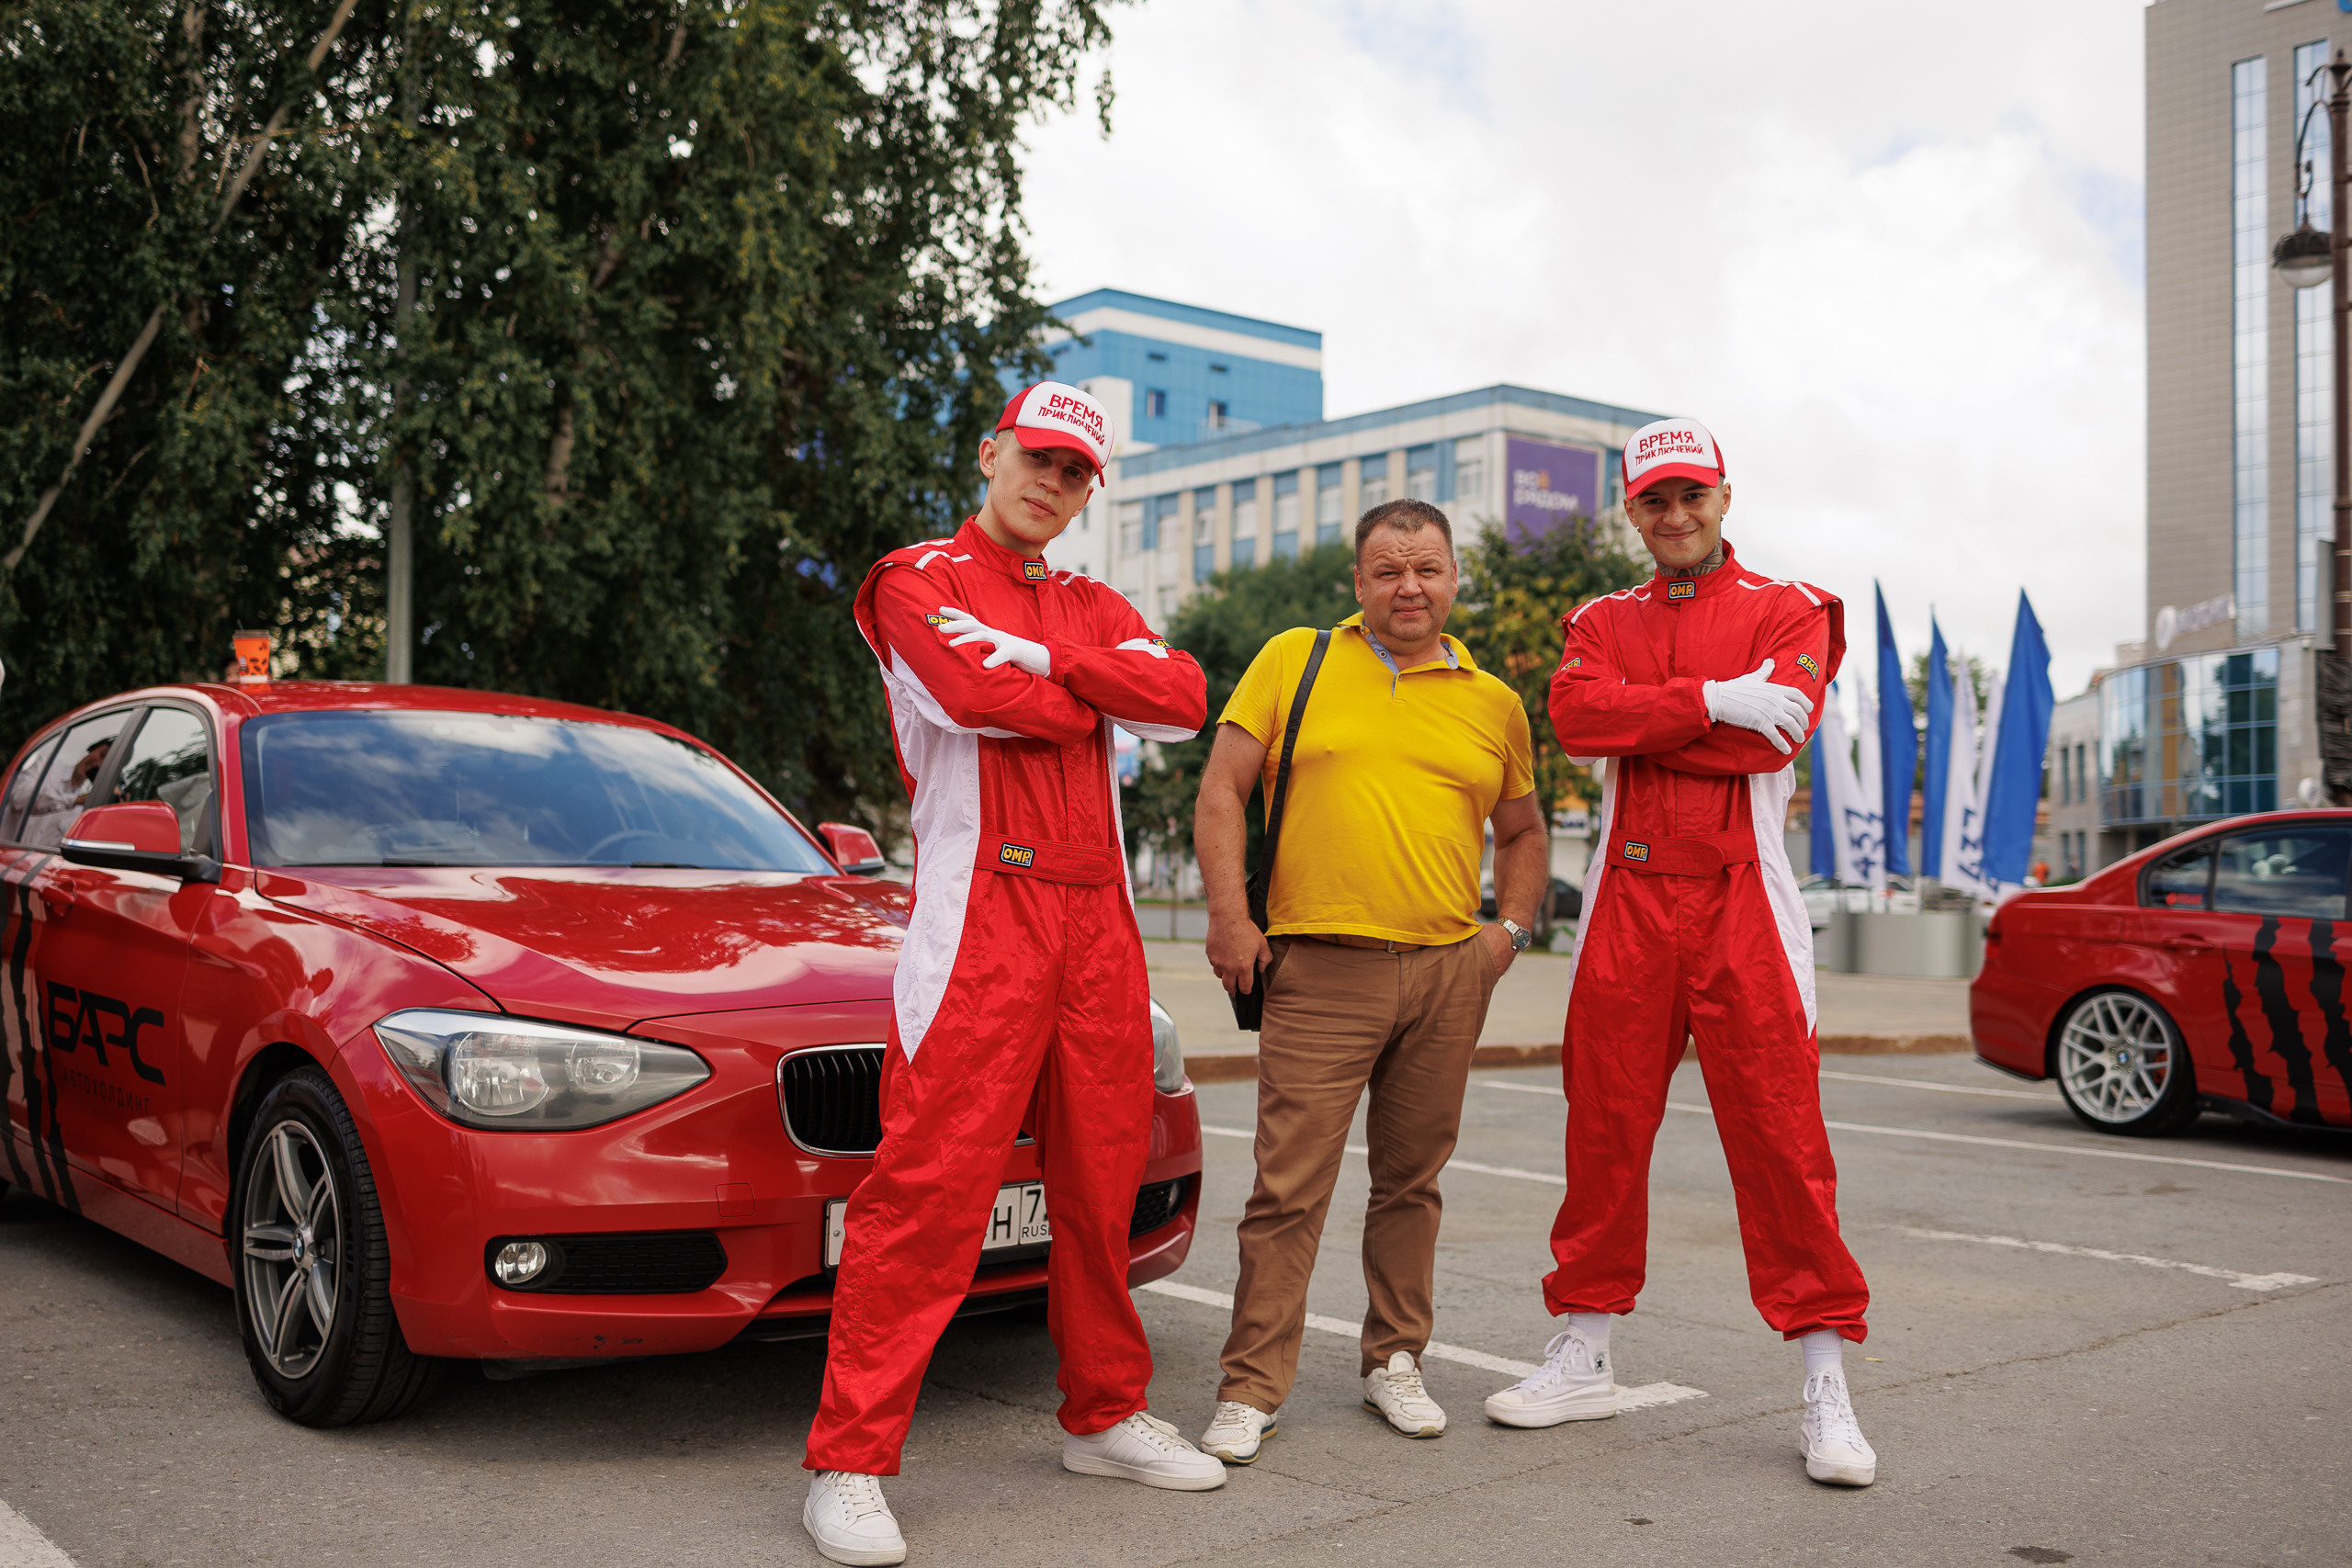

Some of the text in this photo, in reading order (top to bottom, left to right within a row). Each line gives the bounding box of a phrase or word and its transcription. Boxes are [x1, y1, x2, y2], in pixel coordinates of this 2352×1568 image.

[1048, 393, 1103, 432] ВРЕМЯ
[1038, 406, 1105, 447] ПРИКЛЮЧЕНИЙ
[1639, 431, 1695, 453] ВРЕМЯ
[1634, 444, 1704, 467] ПРИКЛЮЧЕНИЙ
[1026, 565, 1044, 577] OMP
[1670, 584, 1693, 596] OMP
[1003, 848, 1031, 863] OMP
[1625, 845, 1646, 859] OMP
[46, 980, 166, 1086] БАРС
[63, 1067, 150, 1114] АВТОХОЛДИНГ
[1022, 1224, 1047, 1238] RUS
